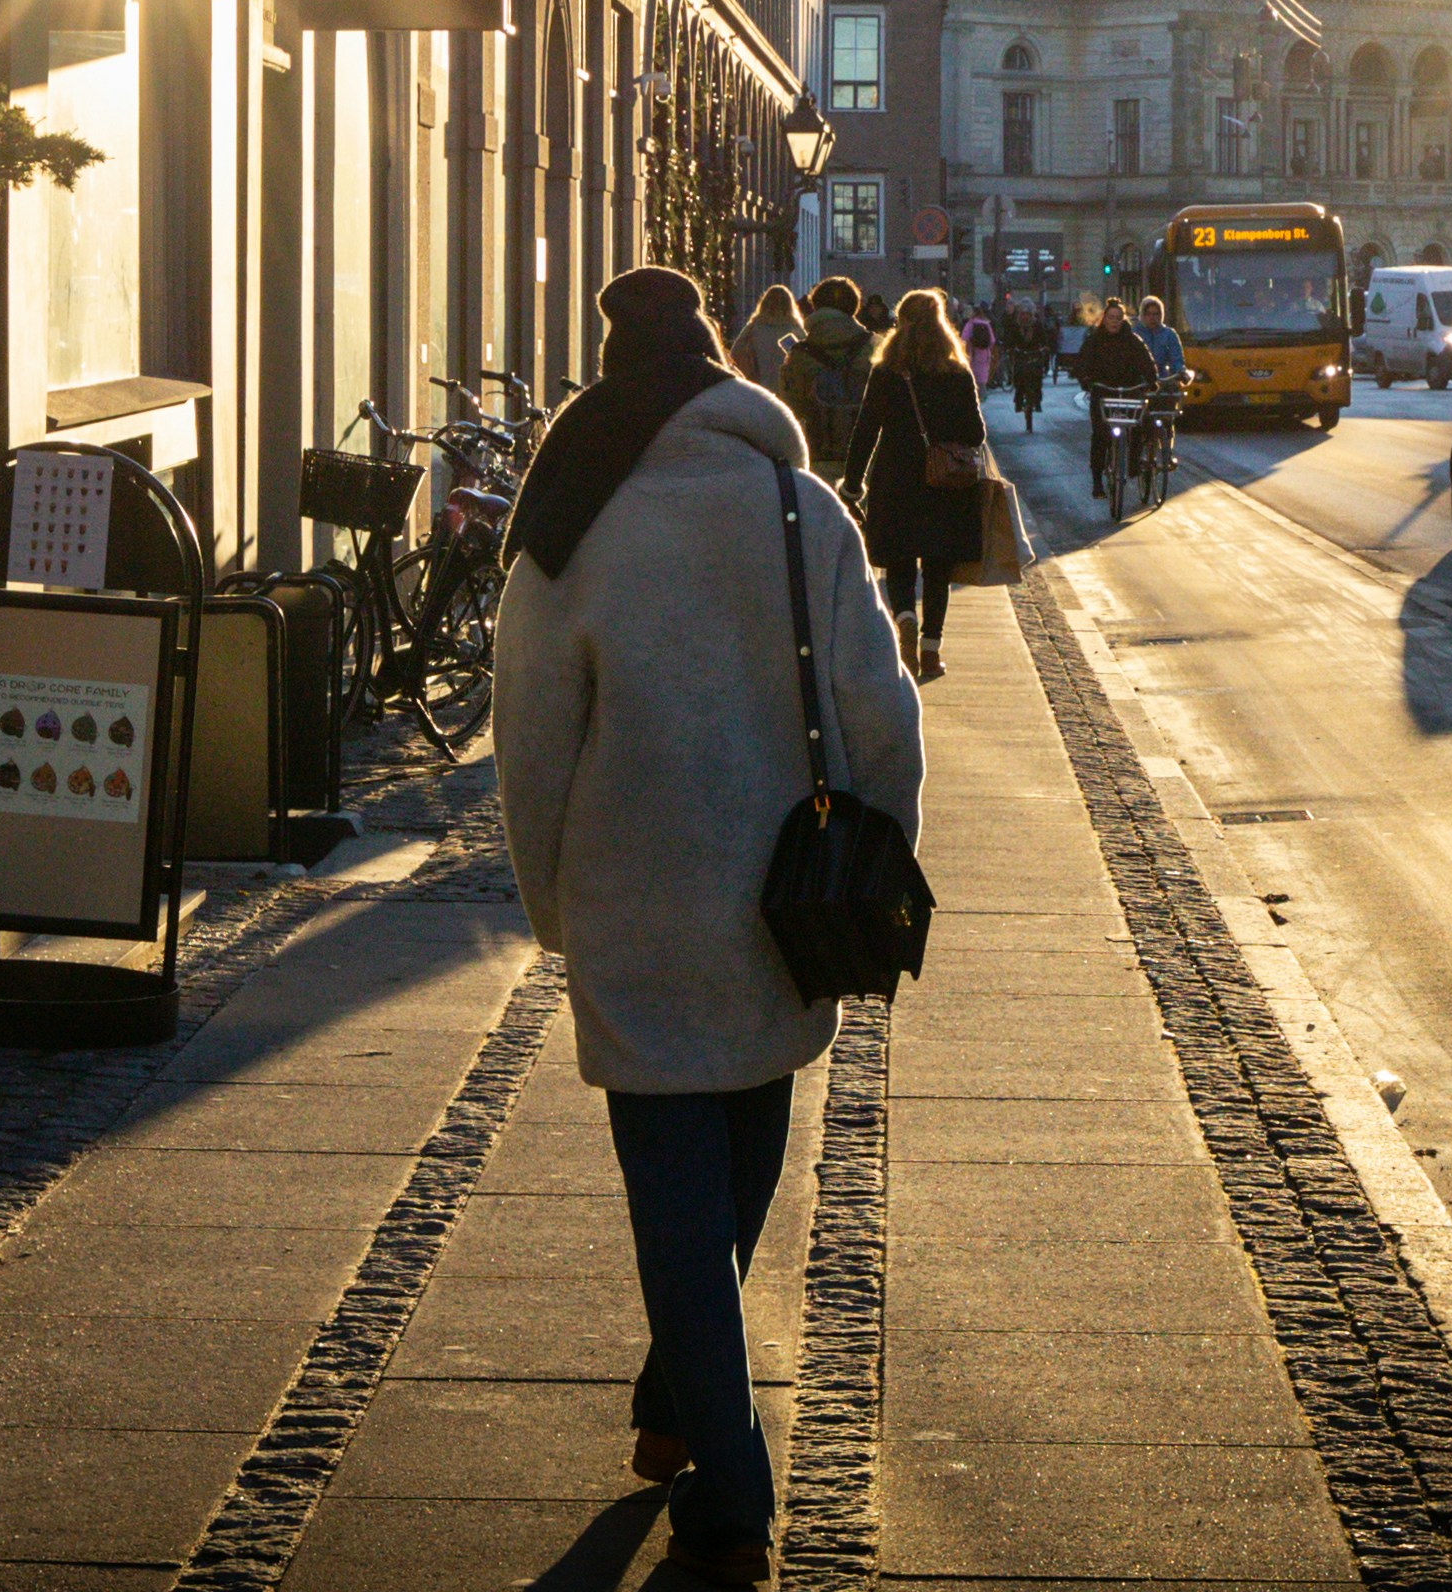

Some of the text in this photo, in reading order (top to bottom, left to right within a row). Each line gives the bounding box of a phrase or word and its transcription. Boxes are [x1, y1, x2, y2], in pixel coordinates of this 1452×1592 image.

[1193, 227, 1216, 247] 23
[1224, 229, 1292, 241] Klampenborg
[49, 683, 82, 695] CORE
[85, 686, 131, 698] FAMILY
